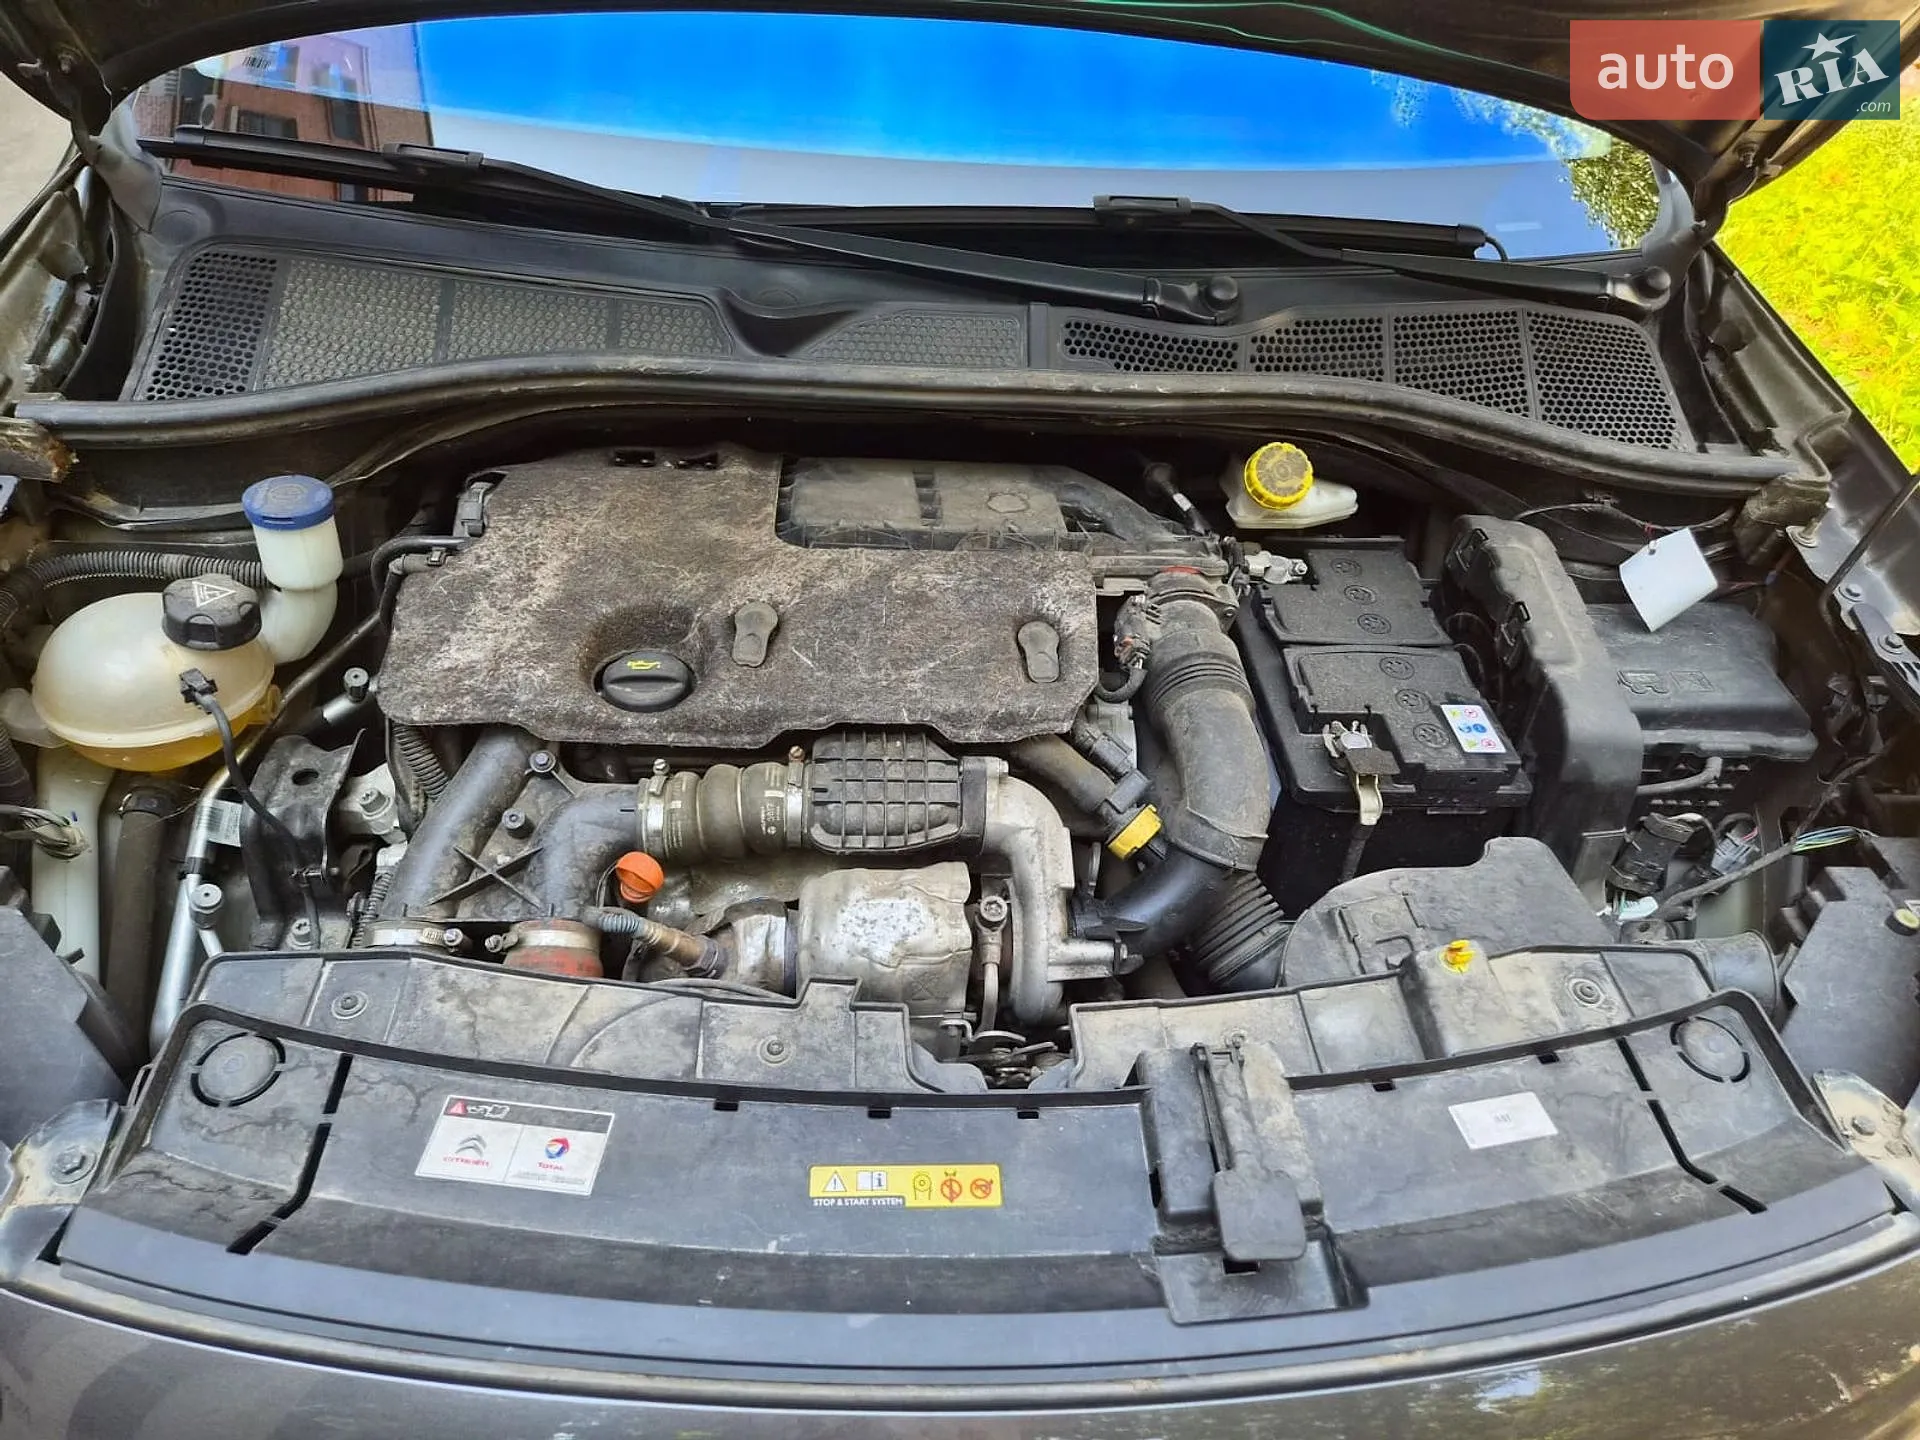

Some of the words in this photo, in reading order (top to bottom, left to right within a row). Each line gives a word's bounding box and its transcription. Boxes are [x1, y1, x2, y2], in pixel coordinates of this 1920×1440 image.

[813, 1198, 834, 1206] STOP
[844, 1198, 869, 1206] START
[872, 1198, 903, 1206] SYSTEM
